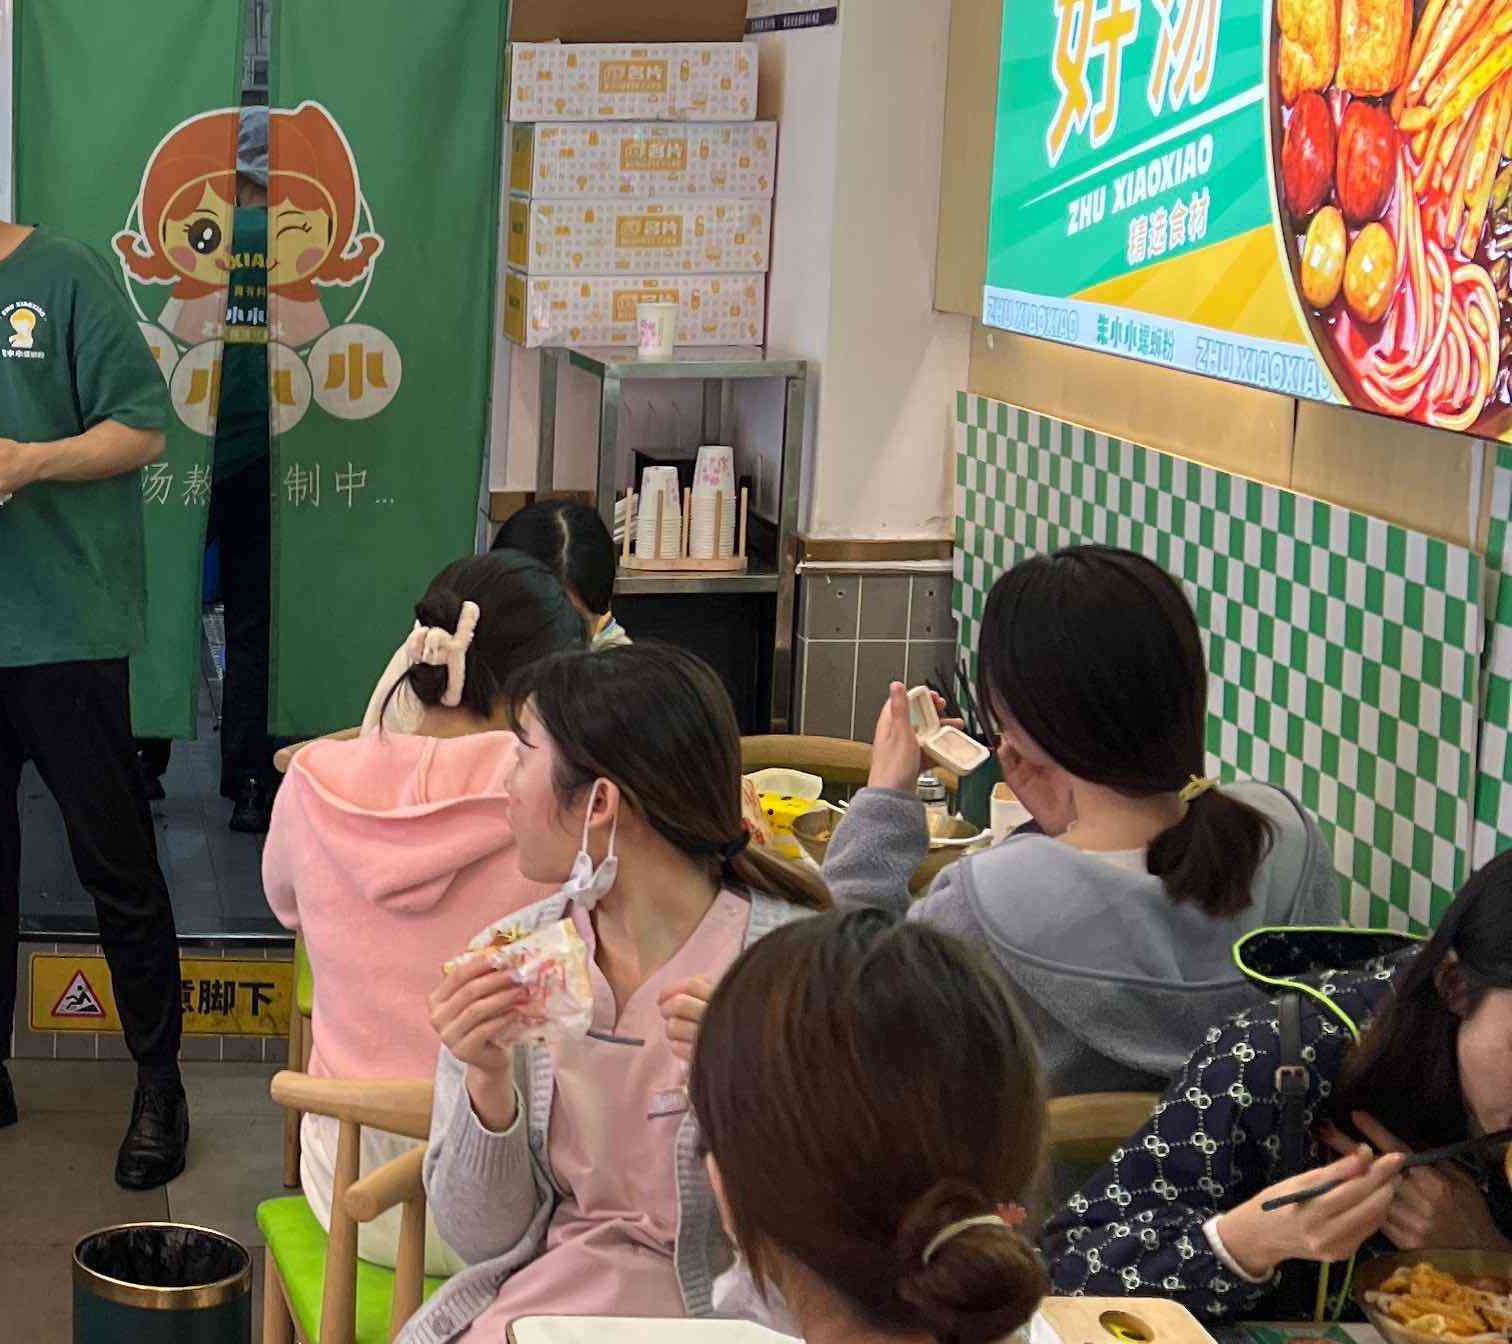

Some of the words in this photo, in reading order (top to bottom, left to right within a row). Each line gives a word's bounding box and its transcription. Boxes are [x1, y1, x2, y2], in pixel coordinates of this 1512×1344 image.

[1067, 185, 1107, 237] ZHU
[1112, 134, 1214, 214] XIAOXIAO
[1127, 187, 1210, 266] 精选食材
[1196, 337, 1234, 377] ZHU
